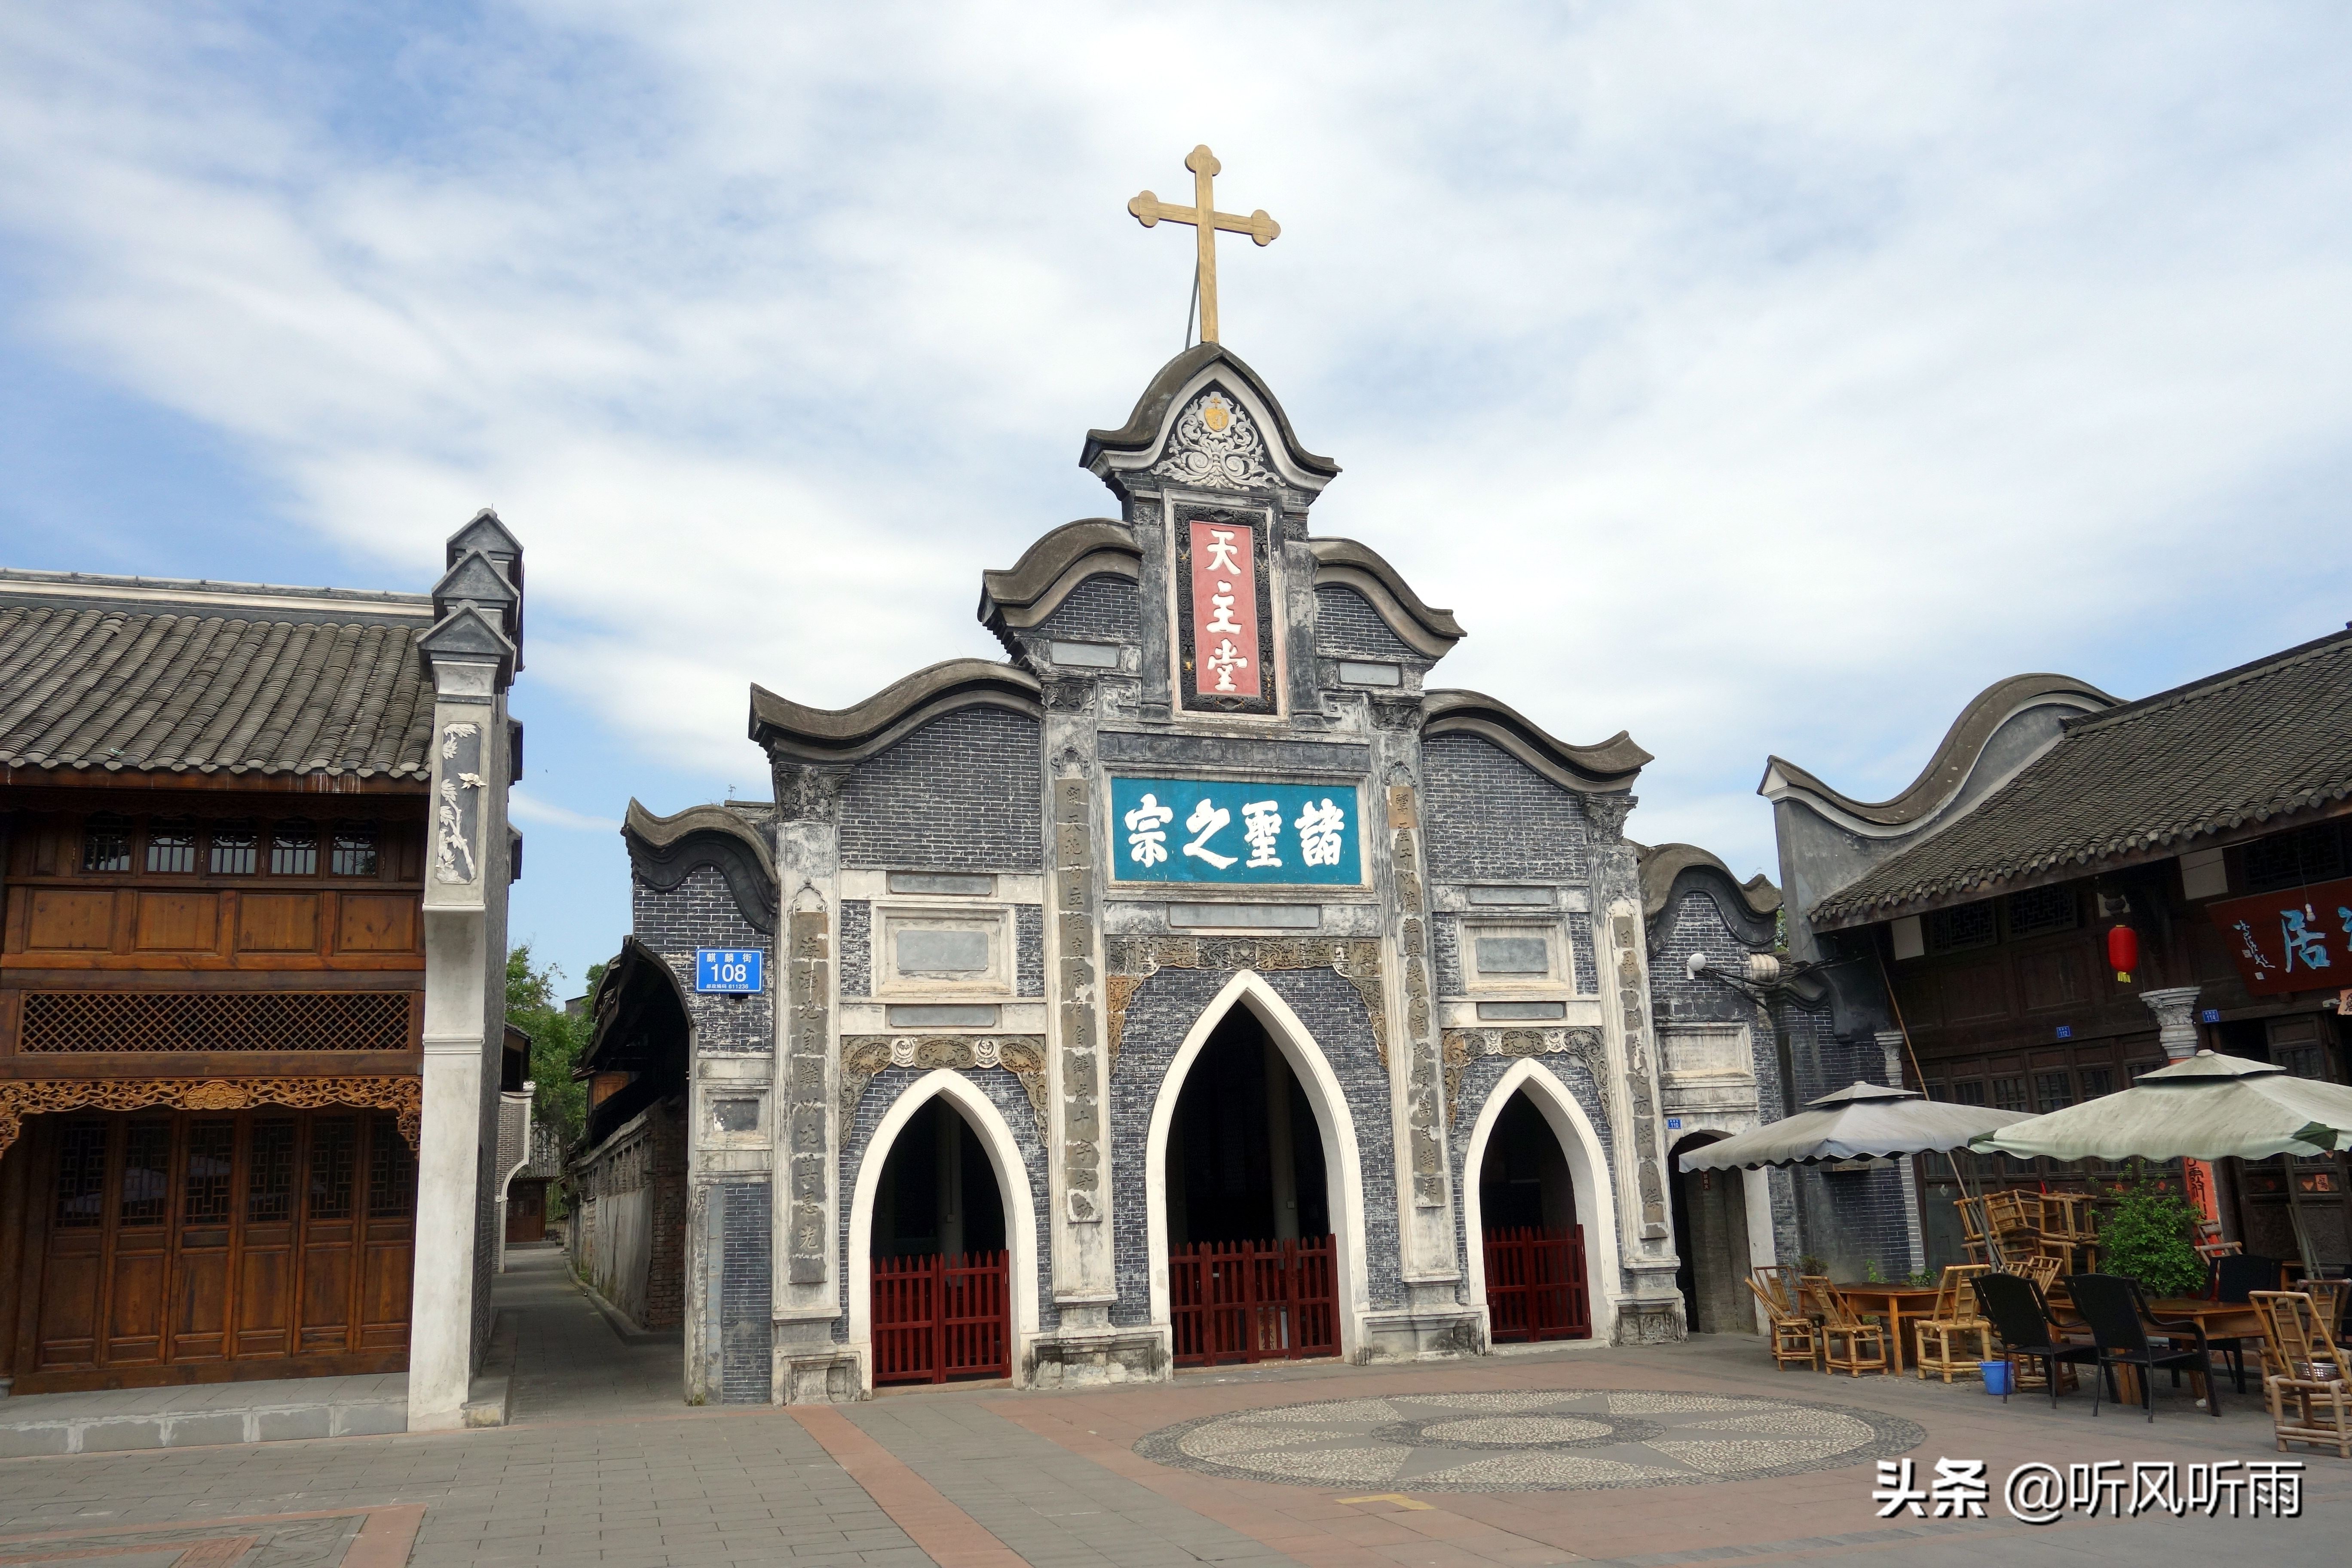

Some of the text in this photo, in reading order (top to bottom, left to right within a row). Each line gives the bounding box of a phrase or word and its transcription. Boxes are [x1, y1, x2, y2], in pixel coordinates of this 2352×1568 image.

[1205, 529, 1248, 692] 天主堂
[706, 952, 752, 963] 麒麟街
[2280, 906, 2352, 973] 居
[711, 964, 746, 982] 108
